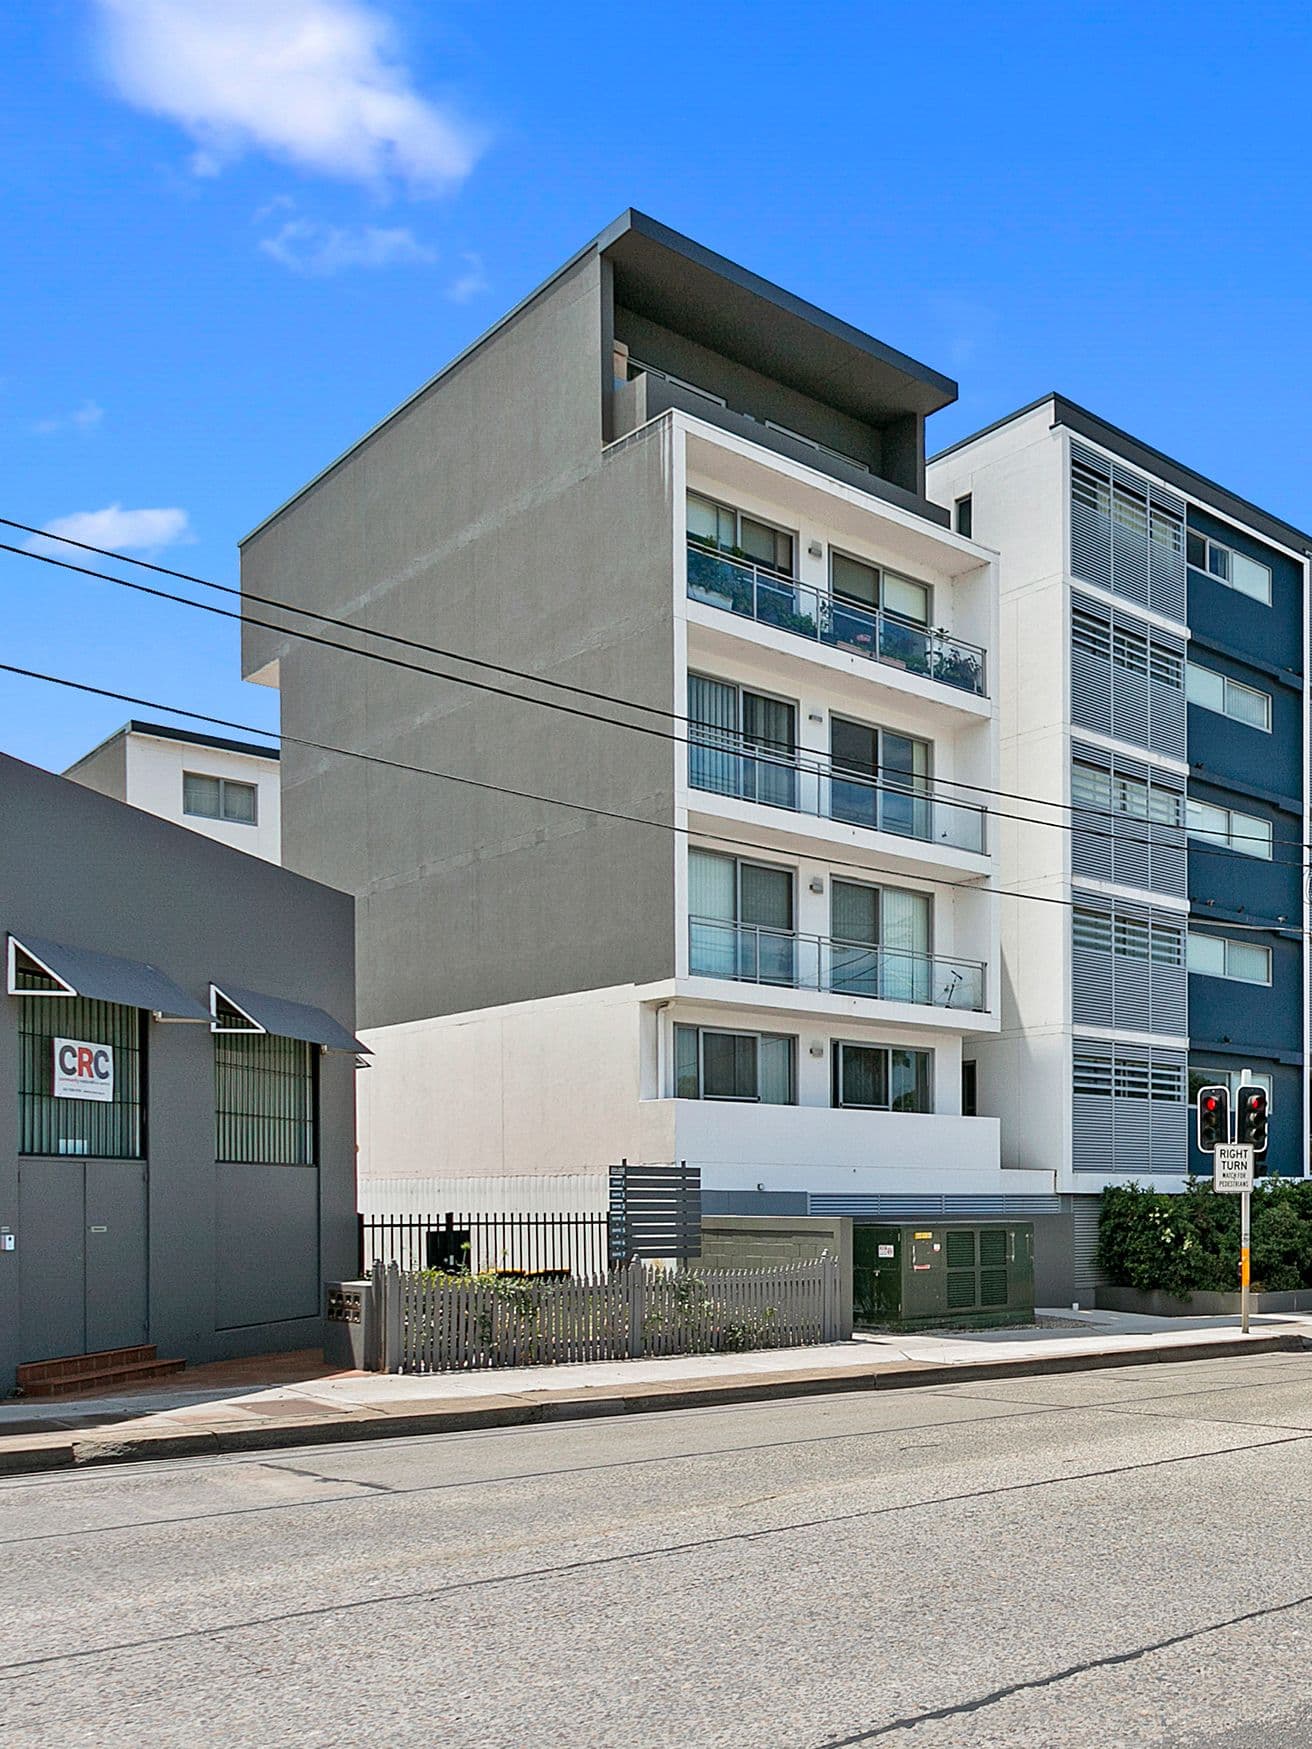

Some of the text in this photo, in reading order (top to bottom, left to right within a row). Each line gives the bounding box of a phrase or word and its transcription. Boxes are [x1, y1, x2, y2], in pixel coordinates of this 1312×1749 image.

[59, 1045, 110, 1079] CRC
[1220, 1149, 1248, 1159] RIGHT
[1222, 1161, 1248, 1170] TURN
